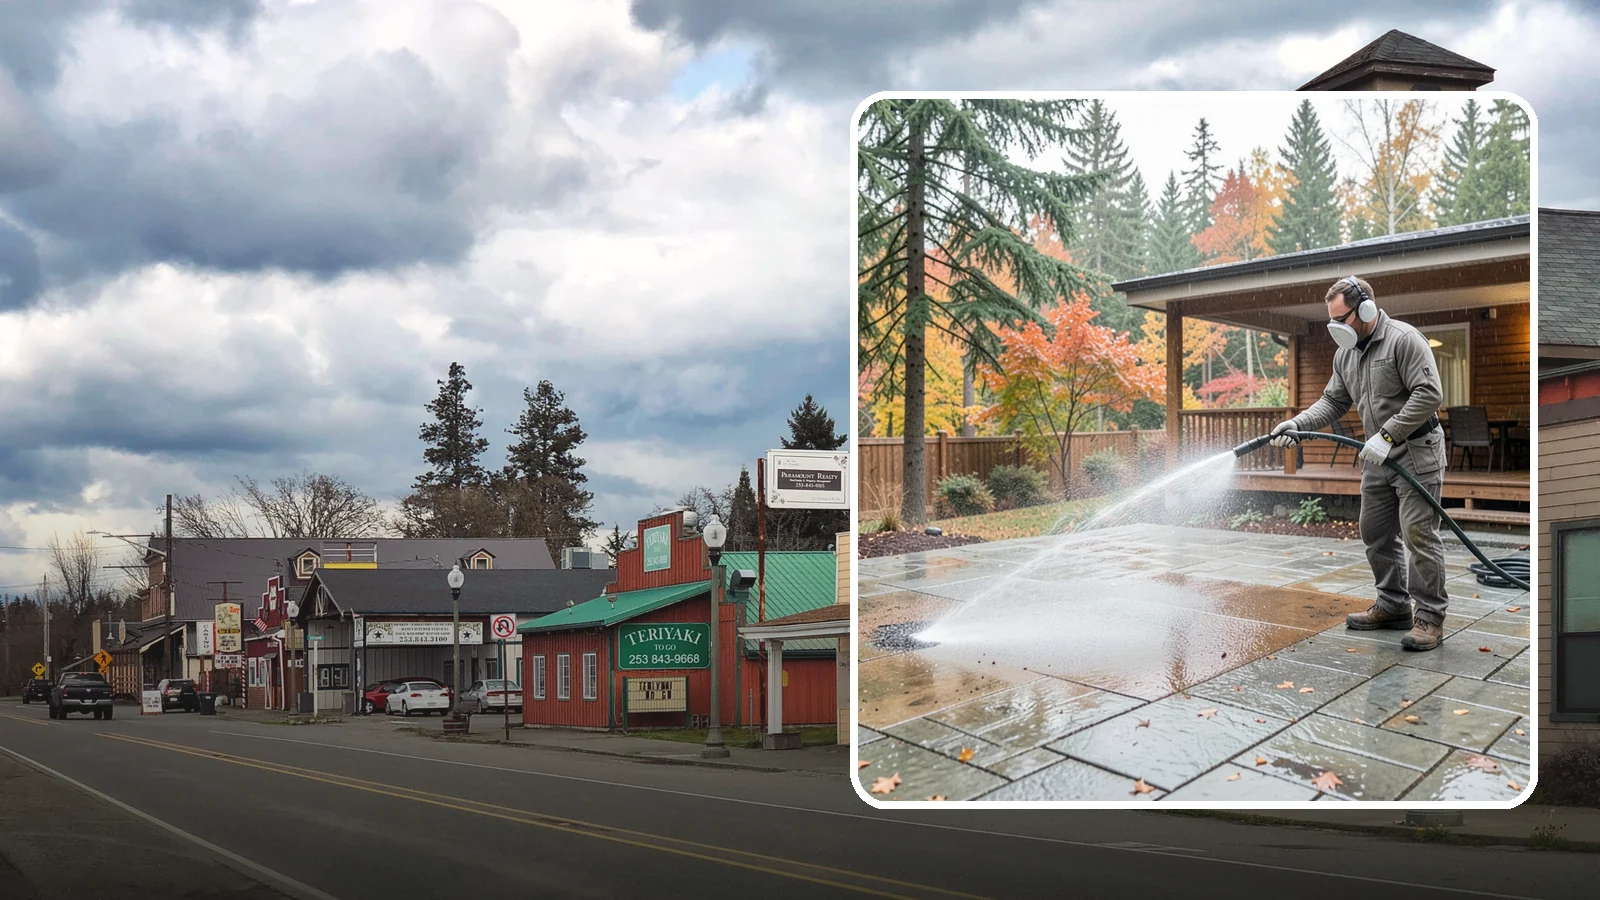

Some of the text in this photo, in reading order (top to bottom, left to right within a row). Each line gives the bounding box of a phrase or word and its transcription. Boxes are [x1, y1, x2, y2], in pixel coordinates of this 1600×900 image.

[781, 471, 838, 480] PARAMOUNT REALTY
[625, 627, 702, 646] TERIYAKI
[629, 654, 700, 664] 253 843-9668
[639, 681, 673, 691] TERIYAKI
